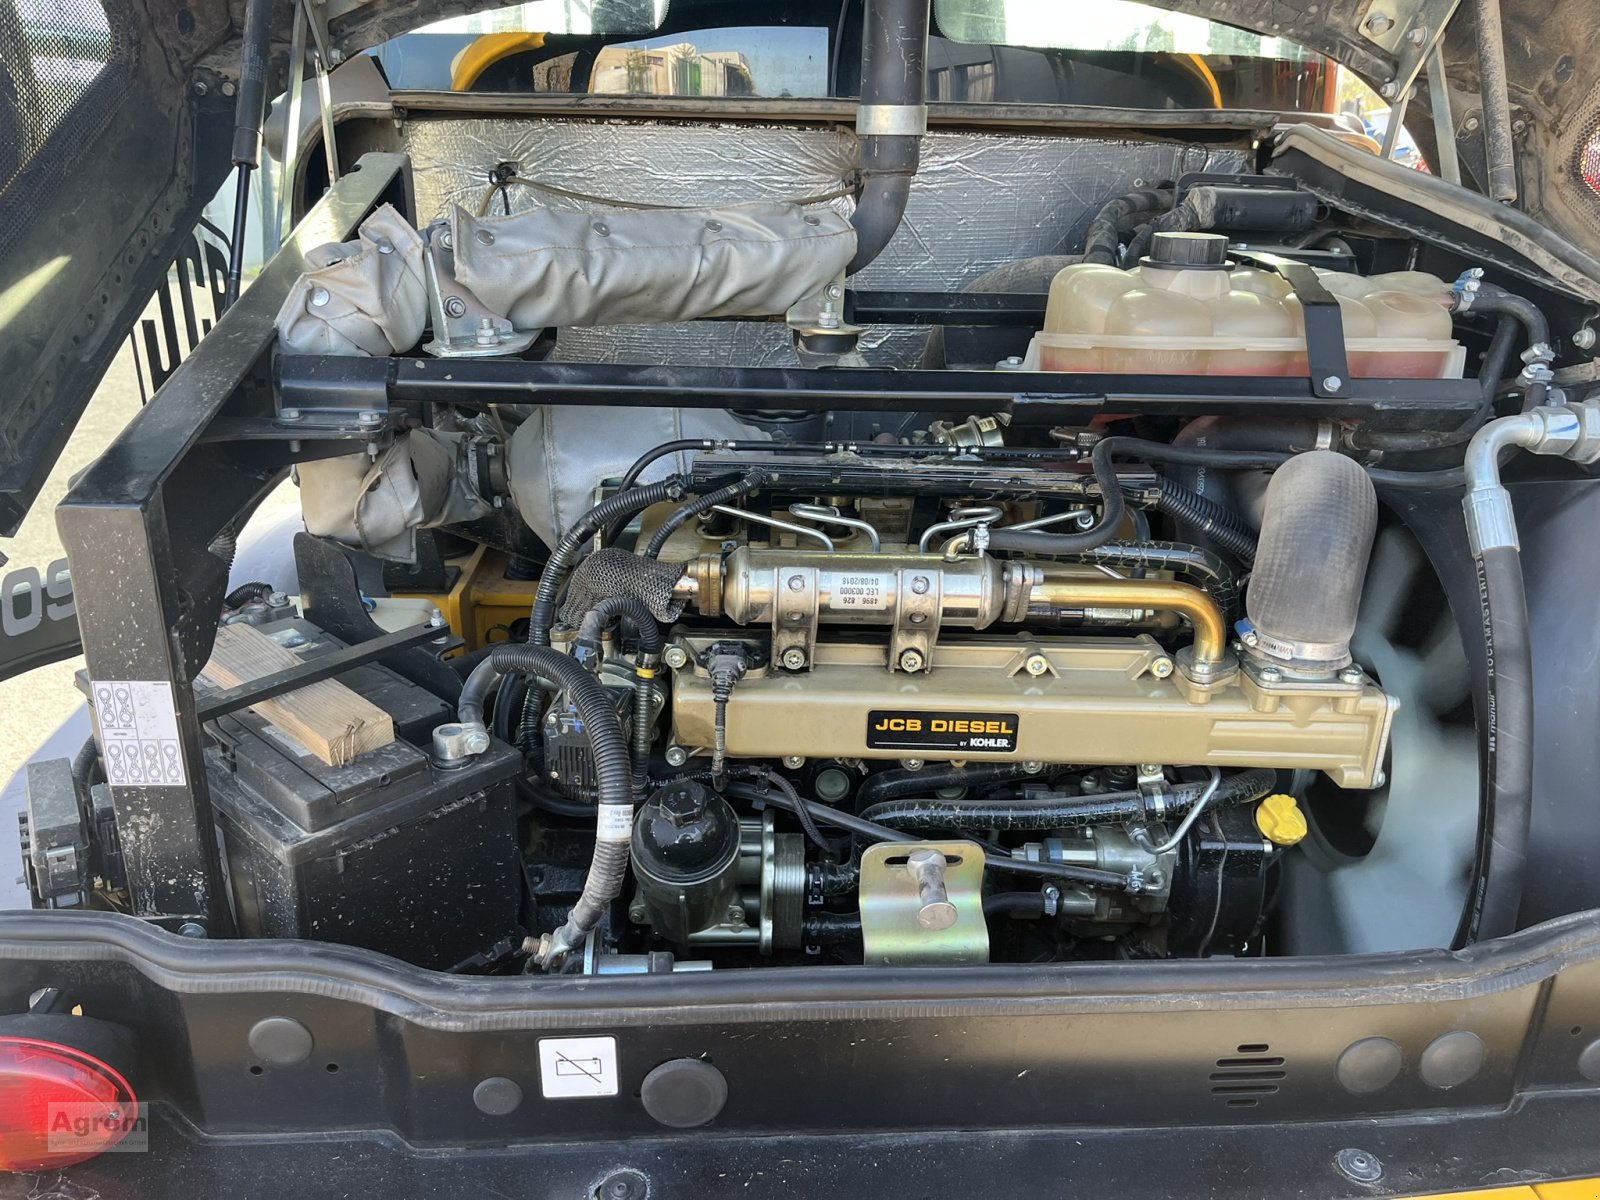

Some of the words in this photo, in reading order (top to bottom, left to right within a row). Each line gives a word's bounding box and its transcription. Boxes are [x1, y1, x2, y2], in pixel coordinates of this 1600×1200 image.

[839, 587, 864, 596] 003000
[866, 587, 879, 596] LEC
[875, 718, 922, 732] JCB
[930, 720, 1014, 734] DIESEL
